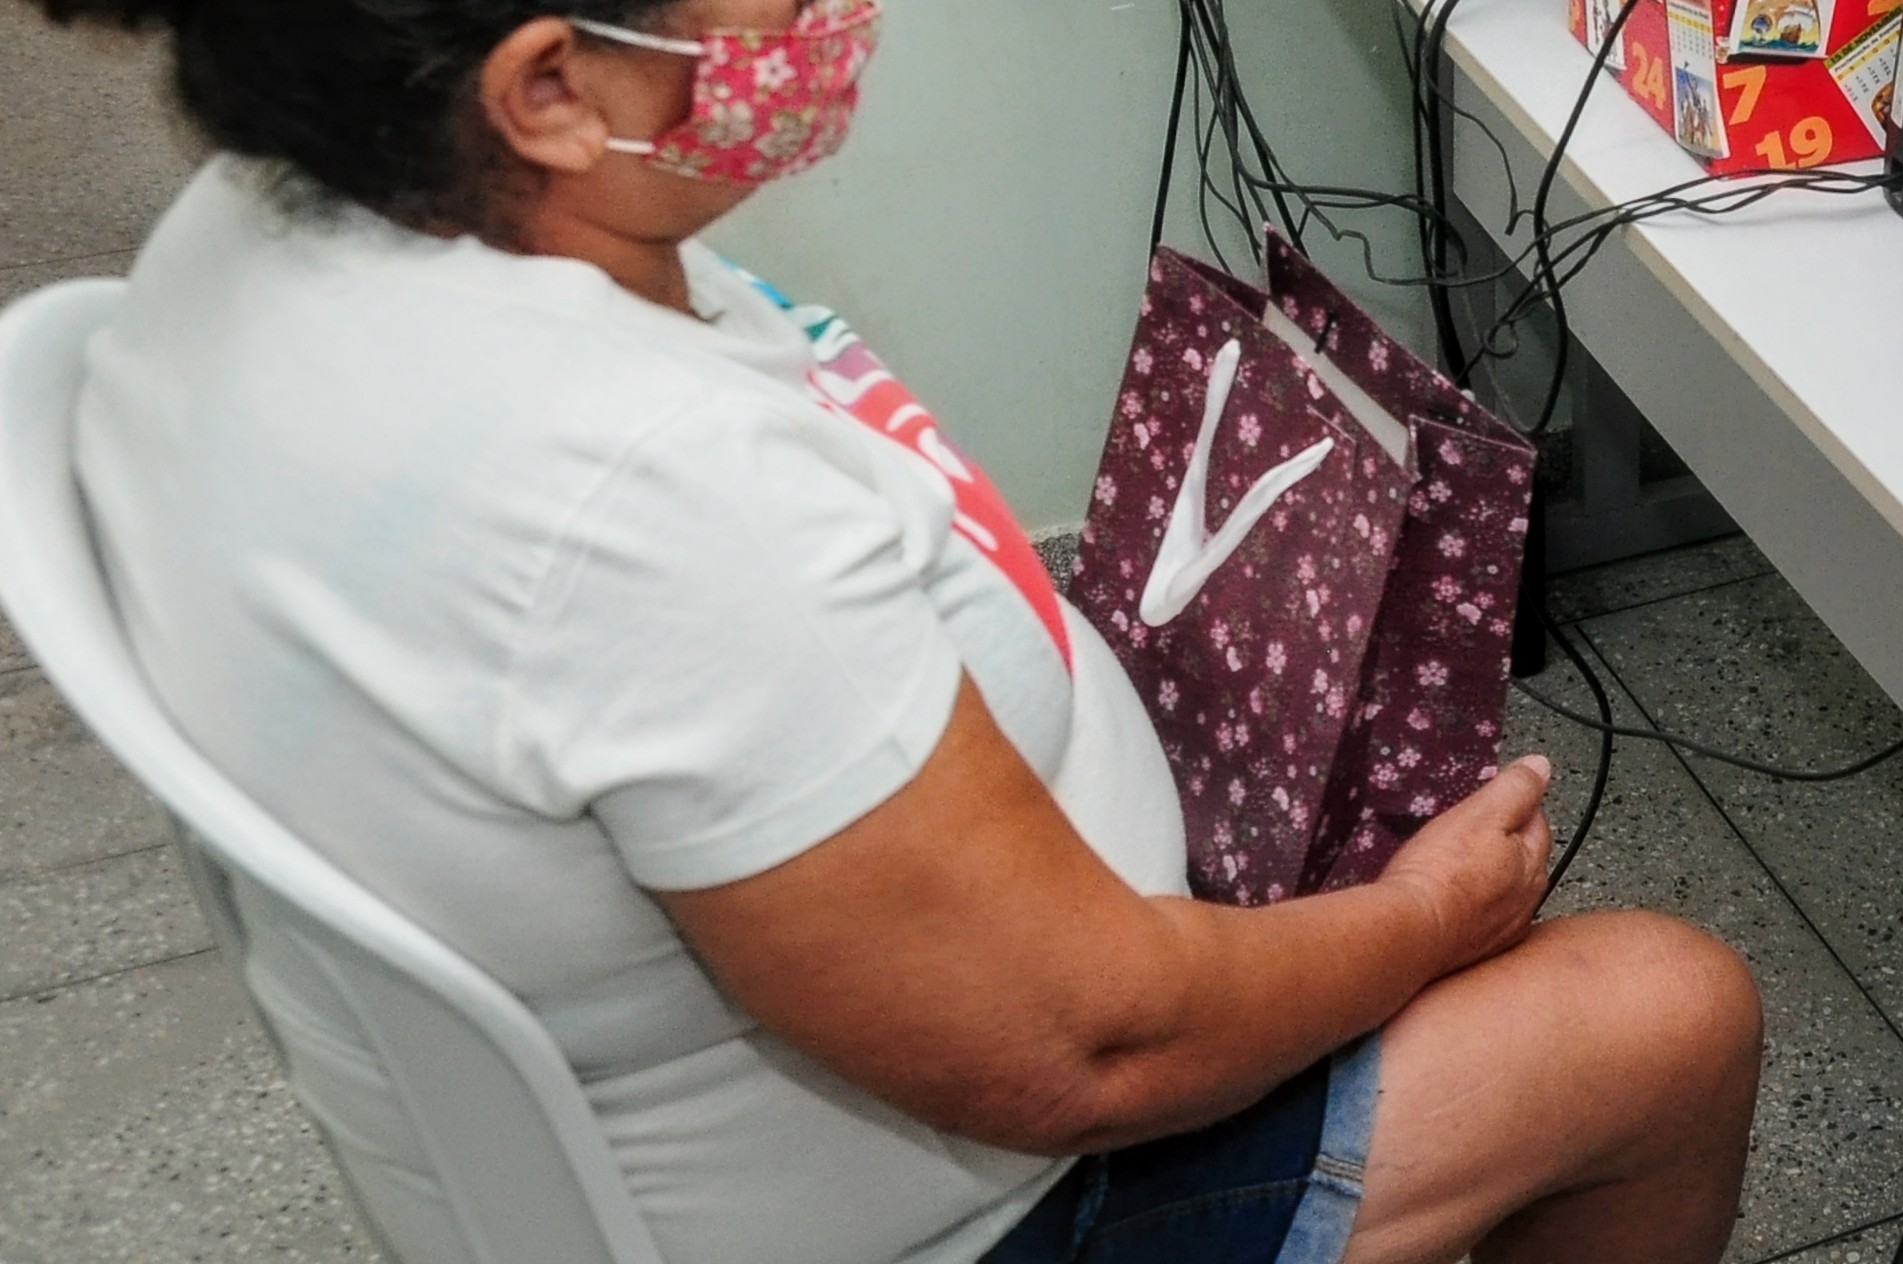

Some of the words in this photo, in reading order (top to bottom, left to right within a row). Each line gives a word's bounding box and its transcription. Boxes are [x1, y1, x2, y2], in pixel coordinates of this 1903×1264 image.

[1632, 41, 1666, 111] 24
[1723, 65, 1767, 126] 7
[1755, 116, 1833, 170] 19
